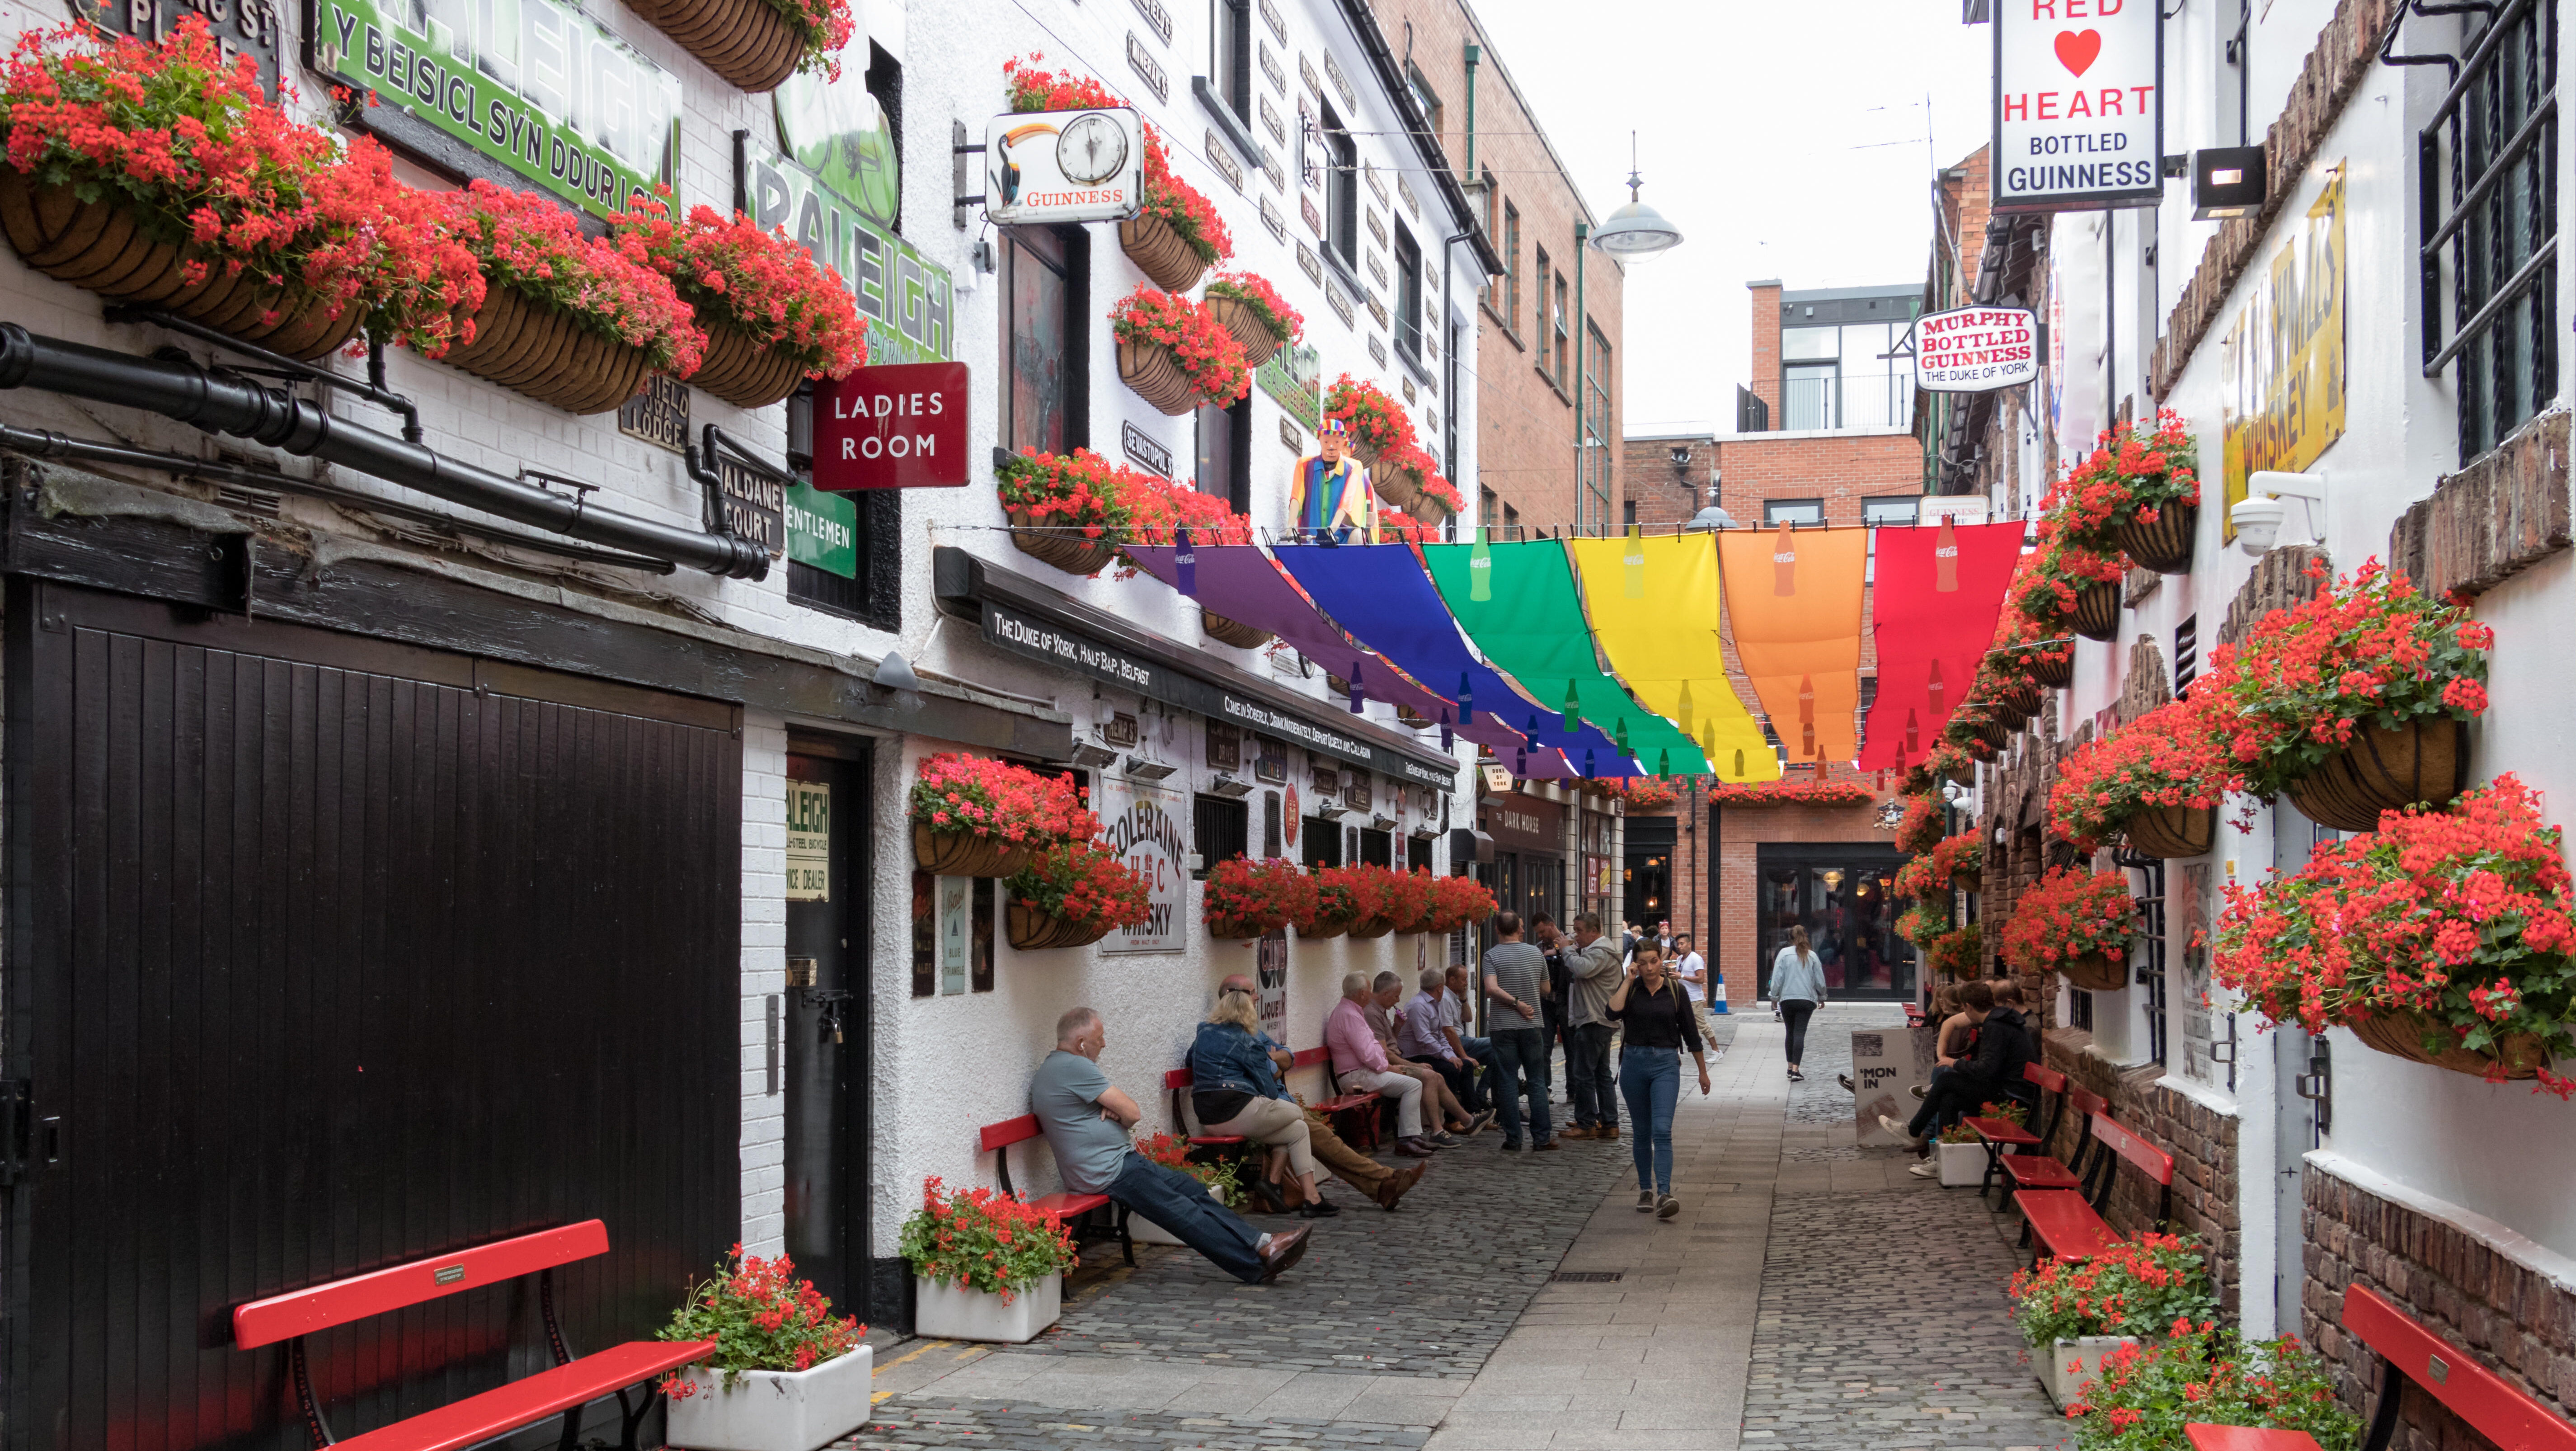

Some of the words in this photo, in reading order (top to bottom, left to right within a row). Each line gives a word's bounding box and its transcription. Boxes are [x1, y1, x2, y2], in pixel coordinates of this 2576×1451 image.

[2033, 0, 2123, 20] RED
[332, 7, 357, 58] Y
[366, 23, 482, 135] BEISICL
[550, 133, 615, 211] DDUR
[377, 0, 673, 194] ALEIGH
[2004, 86, 2154, 122] HEART
[2030, 133, 2127, 155] BOTTLED
[2008, 160, 2151, 192] GUINNESS
[1027, 189, 1122, 208] GUINNESS
[1923, 312, 2028, 335] MURPHY
[1922, 329, 2030, 352] BOTTLED
[1921, 346, 2031, 369] GUINNESS
[1925, 371, 1946, 382] THE
[1950, 369, 1979, 380] DUKE
[1983, 367, 1996, 377] OF
[2000, 362, 2029, 375] YORK
[835, 392, 944, 419] LADIES
[633, 408, 682, 449] LODGE
[2242, 362, 2308, 496] WHISKEY
[843, 433, 936, 460] ROOM
[1127, 429, 1167, 472] SEVASTOPOL
[720, 462, 781, 513] ALDANE
[724, 502, 771, 545] COURT
[1930, 508, 1979, 516] GUINNESS
[787, 504, 850, 549] ENTLEMEN
[995, 612, 1013, 640] THE
[1014, 620, 1039, 648] DUKE
[1041, 633, 1052, 651] OF
[1053, 633, 1077, 663] YORK,
[1080, 643, 1100, 667] HALF
[1121, 659, 1149, 686] BELFAST
[1225, 696, 1240, 716] COME
[1240, 704, 1246, 718] IN
[1270, 711, 1284, 730] DRINK
[1109, 718, 1128, 739] HEMP
[786, 789, 827, 834] ALEIGH
[1505, 810, 1519, 829] DARK
[1522, 814, 1539, 834] HORSE
[786, 837, 807, 849] LL-STEEL
[809, 839, 827, 850] BICYCLE
[1106, 801, 1184, 880] COLERAINE
[1589, 857, 1596, 875] TO
[804, 869, 825, 890] DEALER
[1589, 877, 1597, 893] LET
[949, 947, 960, 958] BLUE
[1261, 939, 1286, 972] CLUB
[945, 966, 964, 976] TRIANGLE
[1260, 991, 1286, 1021] LIQUEUR
[1266, 1021, 1281, 1031] WHISKY
[1860, 1067, 1896, 1078] 'MON
[1864, 1079, 1879, 1089] IN
